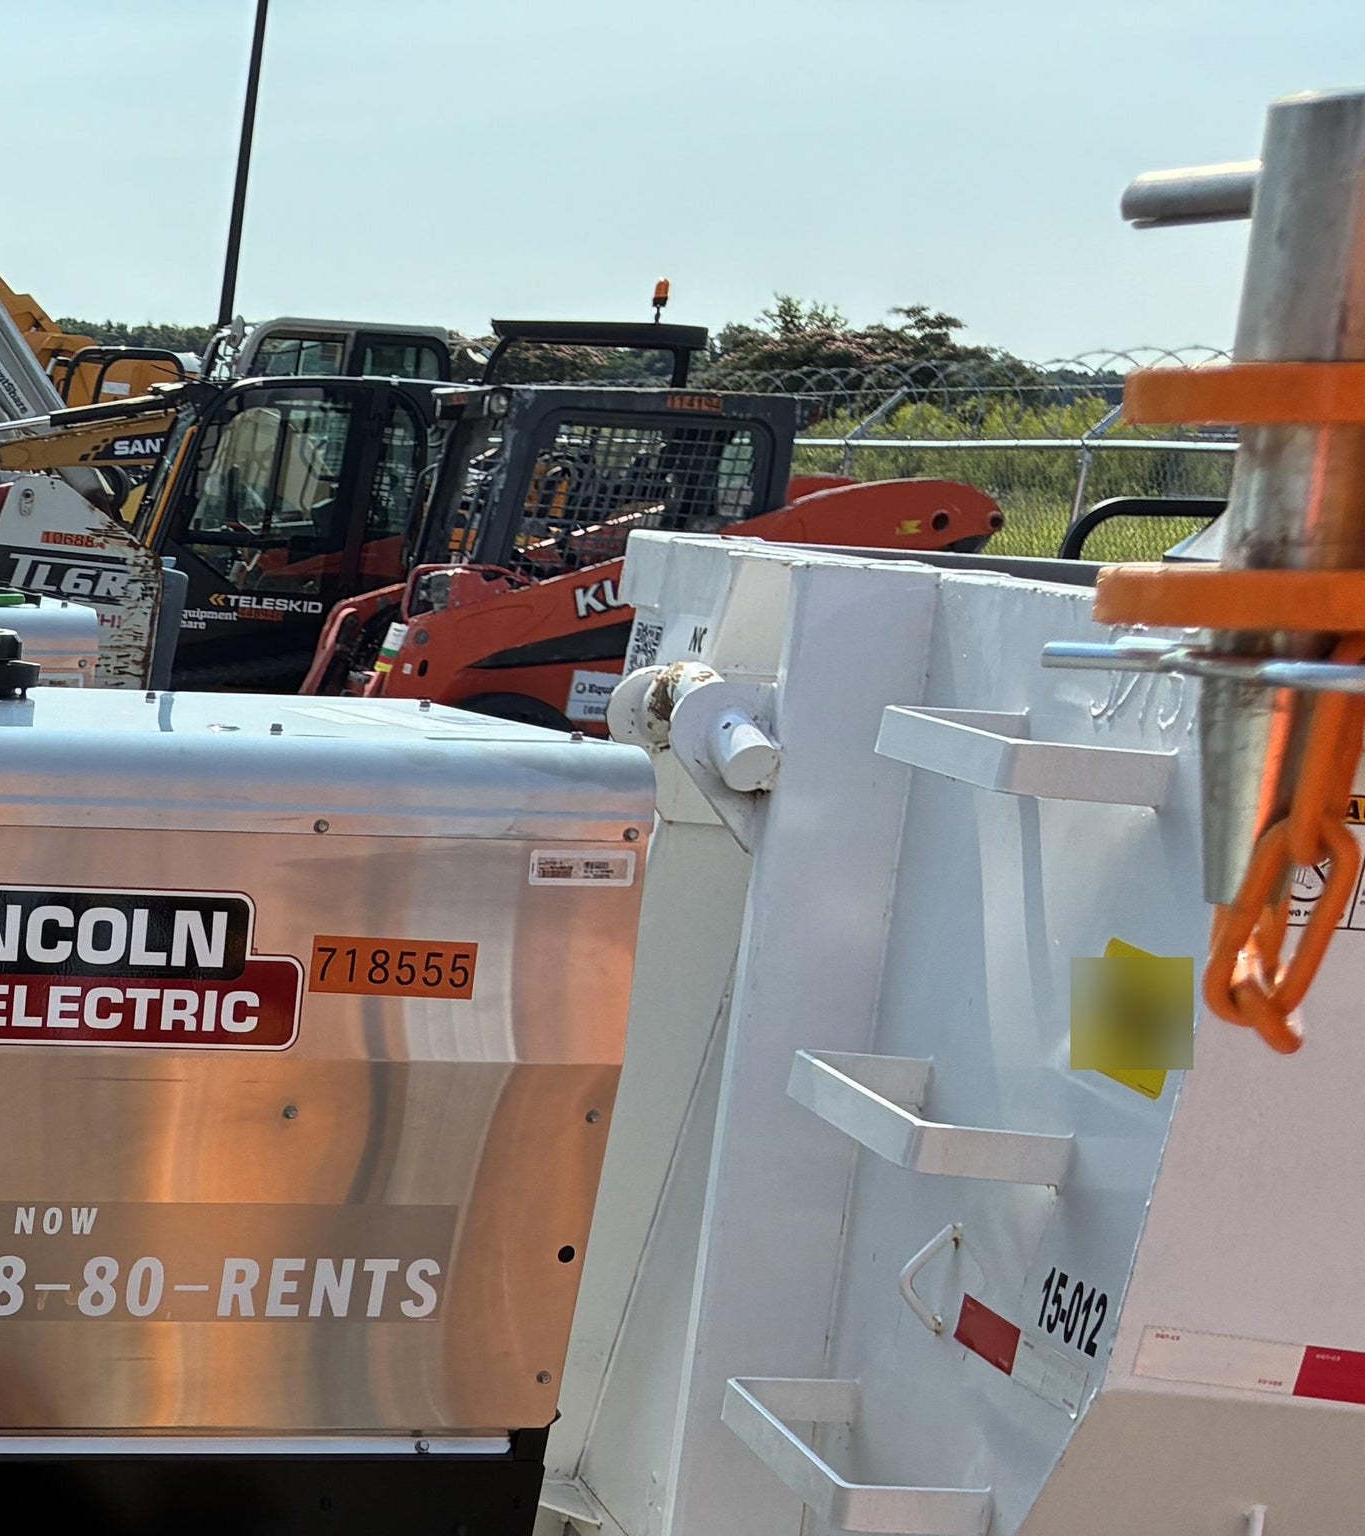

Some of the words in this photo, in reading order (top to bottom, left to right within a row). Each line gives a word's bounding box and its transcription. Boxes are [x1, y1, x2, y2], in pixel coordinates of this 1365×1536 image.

[114, 438, 165, 455] SAN
[44, 531, 106, 549] 10688
[10, 553, 131, 598] TL6R
[226, 594, 324, 614] TELESKID
[316, 946, 471, 989] 718555
[14, 1207, 98, 1236] NOW
[1038, 1266, 1108, 1358] 15-012
